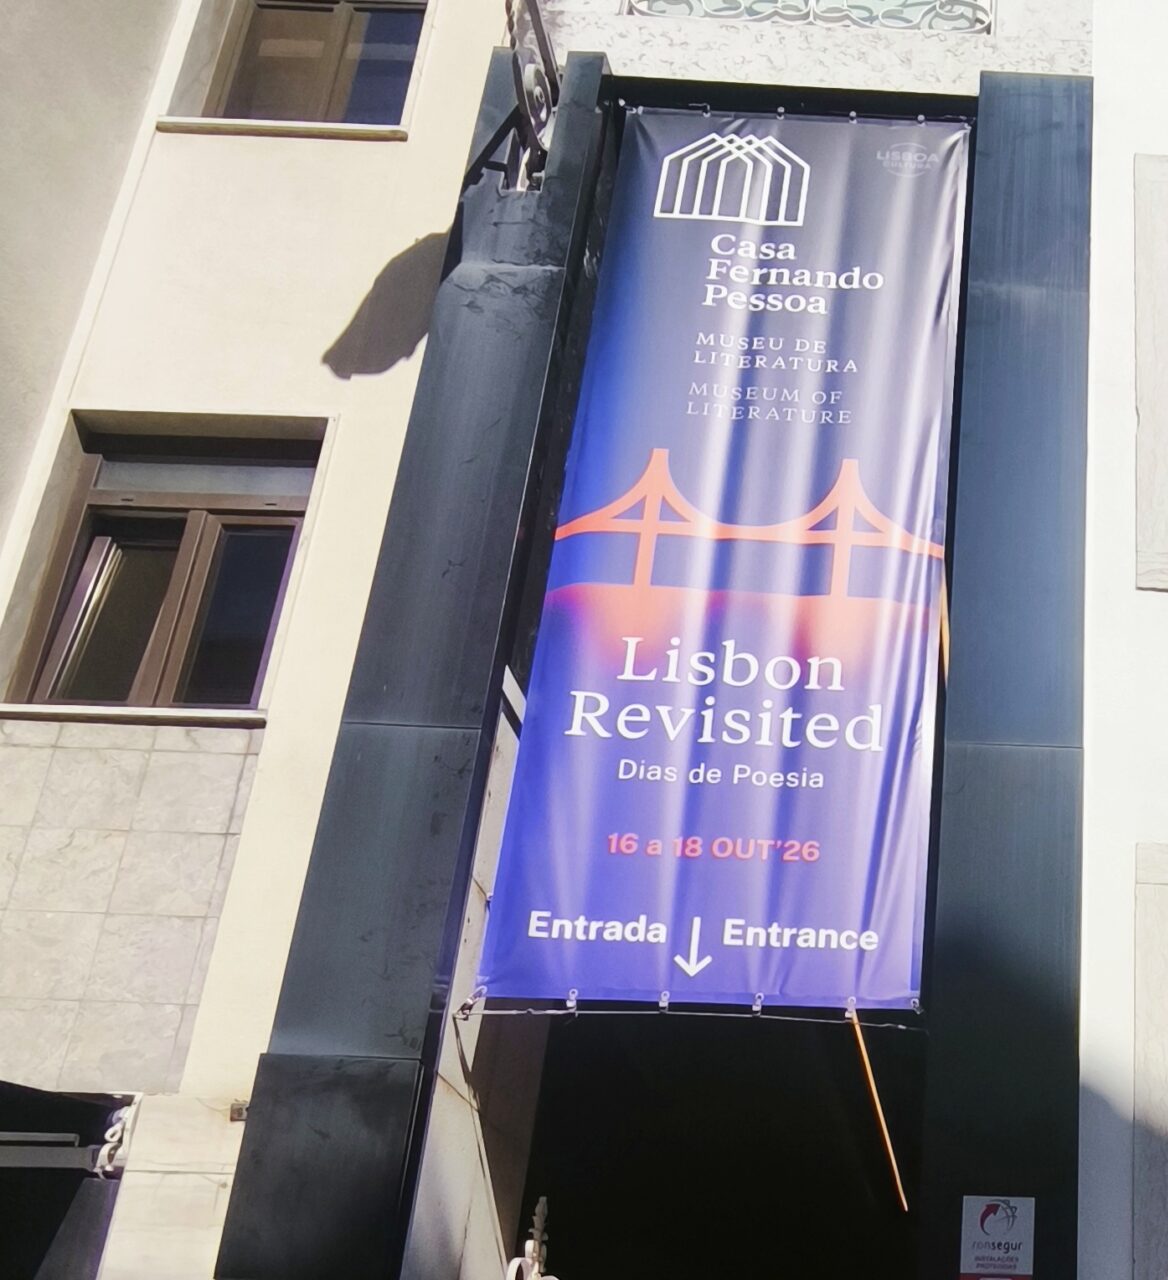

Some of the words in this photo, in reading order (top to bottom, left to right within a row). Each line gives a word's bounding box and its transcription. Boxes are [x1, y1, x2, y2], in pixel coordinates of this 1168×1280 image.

[877, 150, 939, 163] LISBOA
[711, 234, 797, 260] Casa
[706, 258, 885, 290] Fernando
[702, 284, 828, 315] Pessoa
[696, 332, 785, 351] MUSEU
[795, 339, 827, 354] DE
[693, 351, 858, 373] LITERATURA
[688, 382, 799, 402] MUSEUM
[811, 391, 843, 405] OF
[686, 401, 852, 424] LITERATURE
[617, 636, 845, 691] Lisbon
[564, 690, 884, 752] Revisited
[618, 759, 678, 782] Dias
[688, 763, 722, 784] de
[732, 765, 825, 788] Poesia
[607, 832, 638, 855] 16
[646, 840, 663, 856] a
[672, 837, 703, 858] 18
[711, 837, 820, 862] OUT'26
[528, 911, 667, 944] Entrada
[722, 918, 879, 951] Entrance
